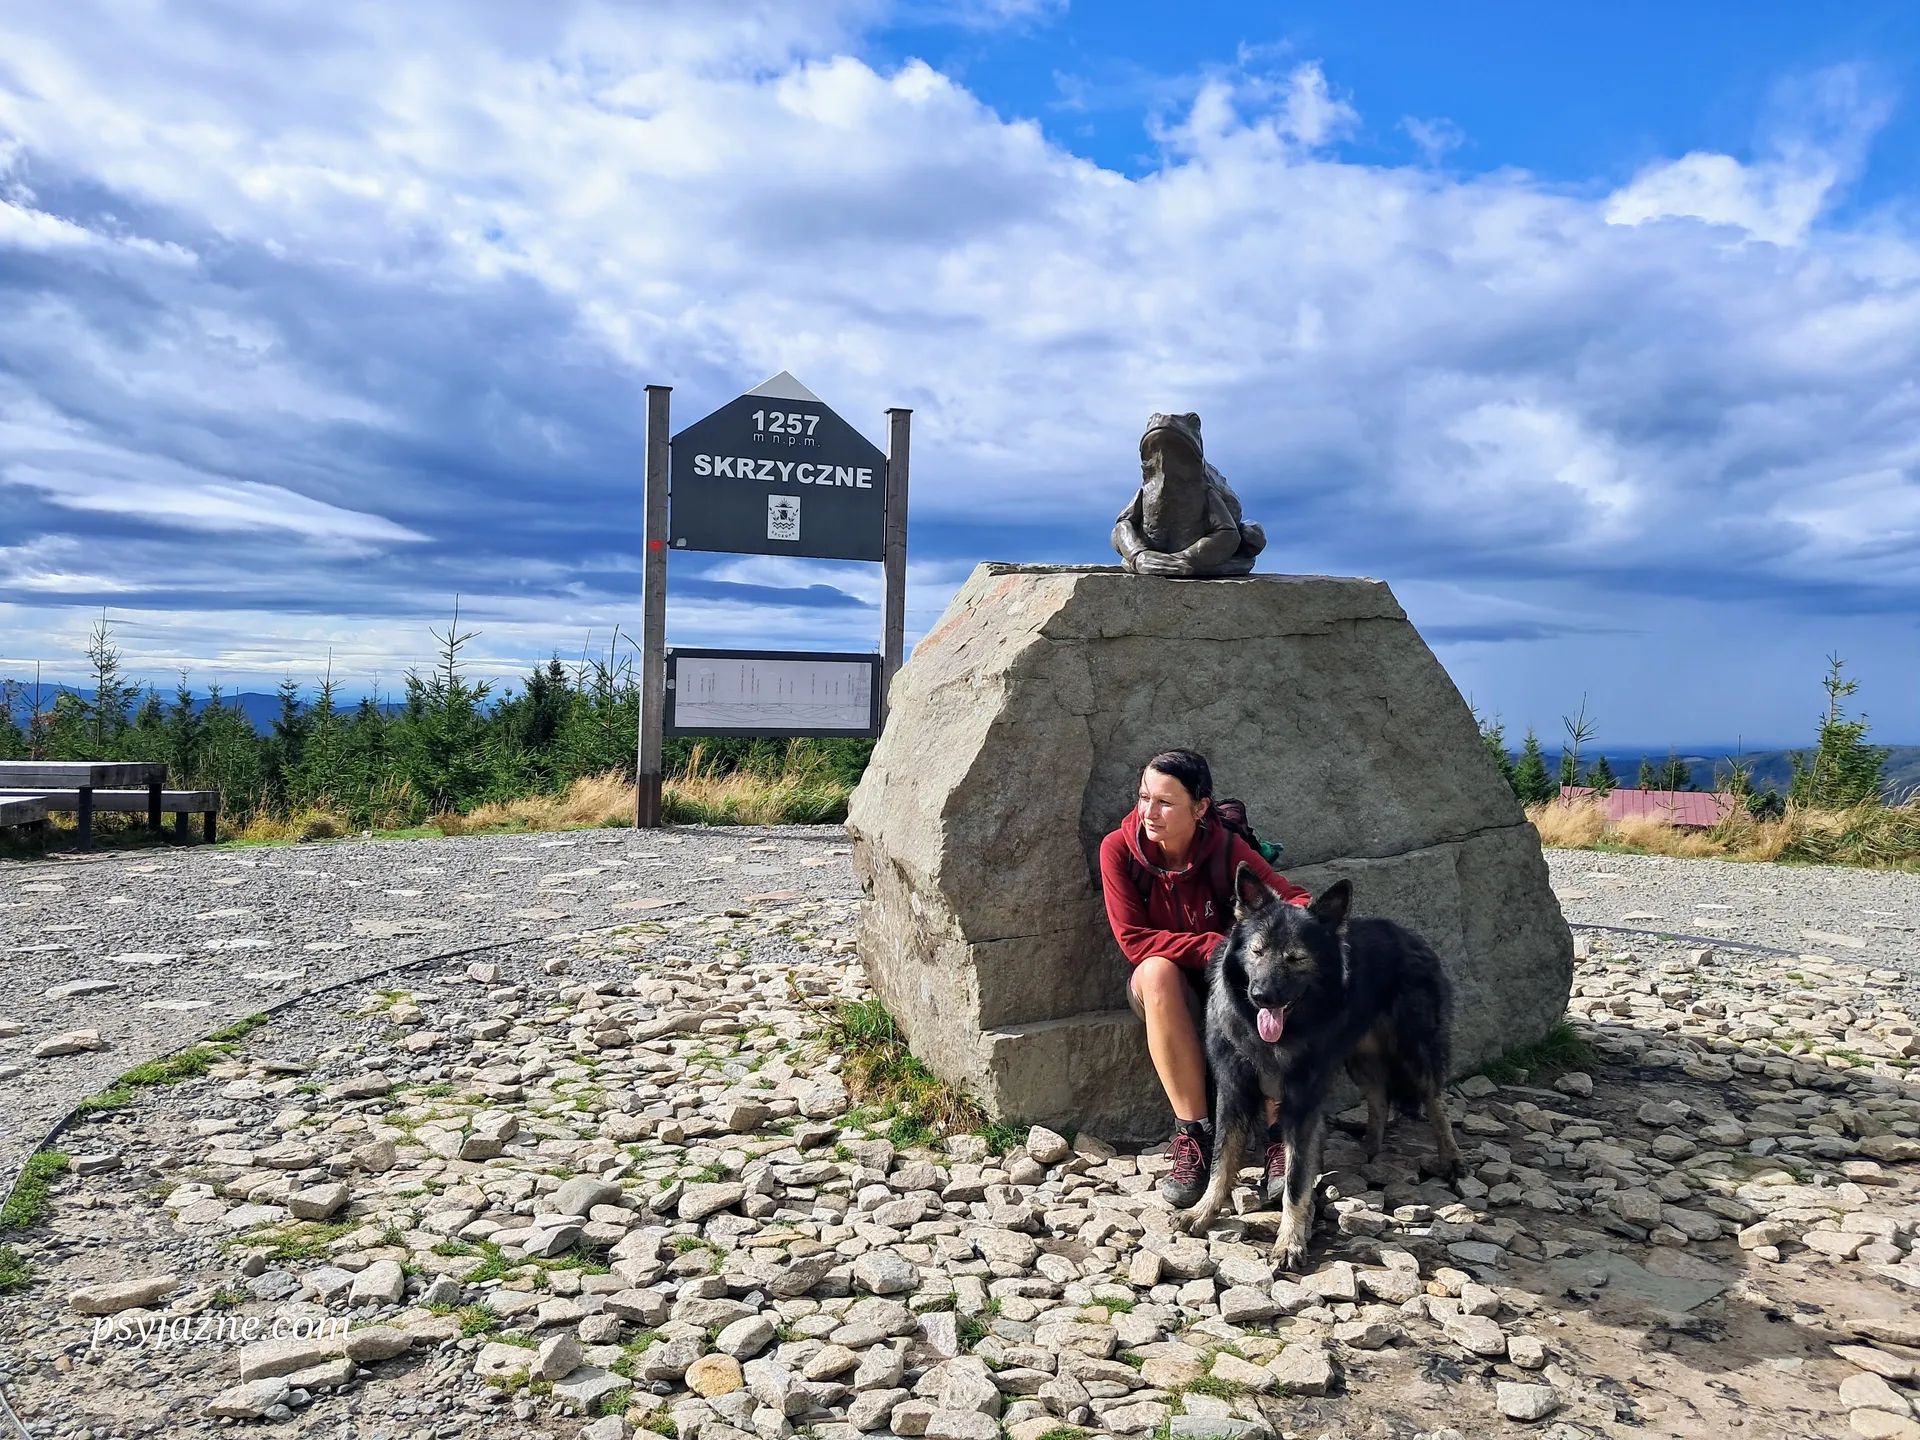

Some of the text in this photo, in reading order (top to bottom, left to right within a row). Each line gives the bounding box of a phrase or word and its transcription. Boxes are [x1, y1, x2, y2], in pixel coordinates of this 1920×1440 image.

[752, 409, 820, 436] 1257
[753, 433, 820, 447] m n.p.m.
[693, 454, 873, 489] SKRZYCZNE
